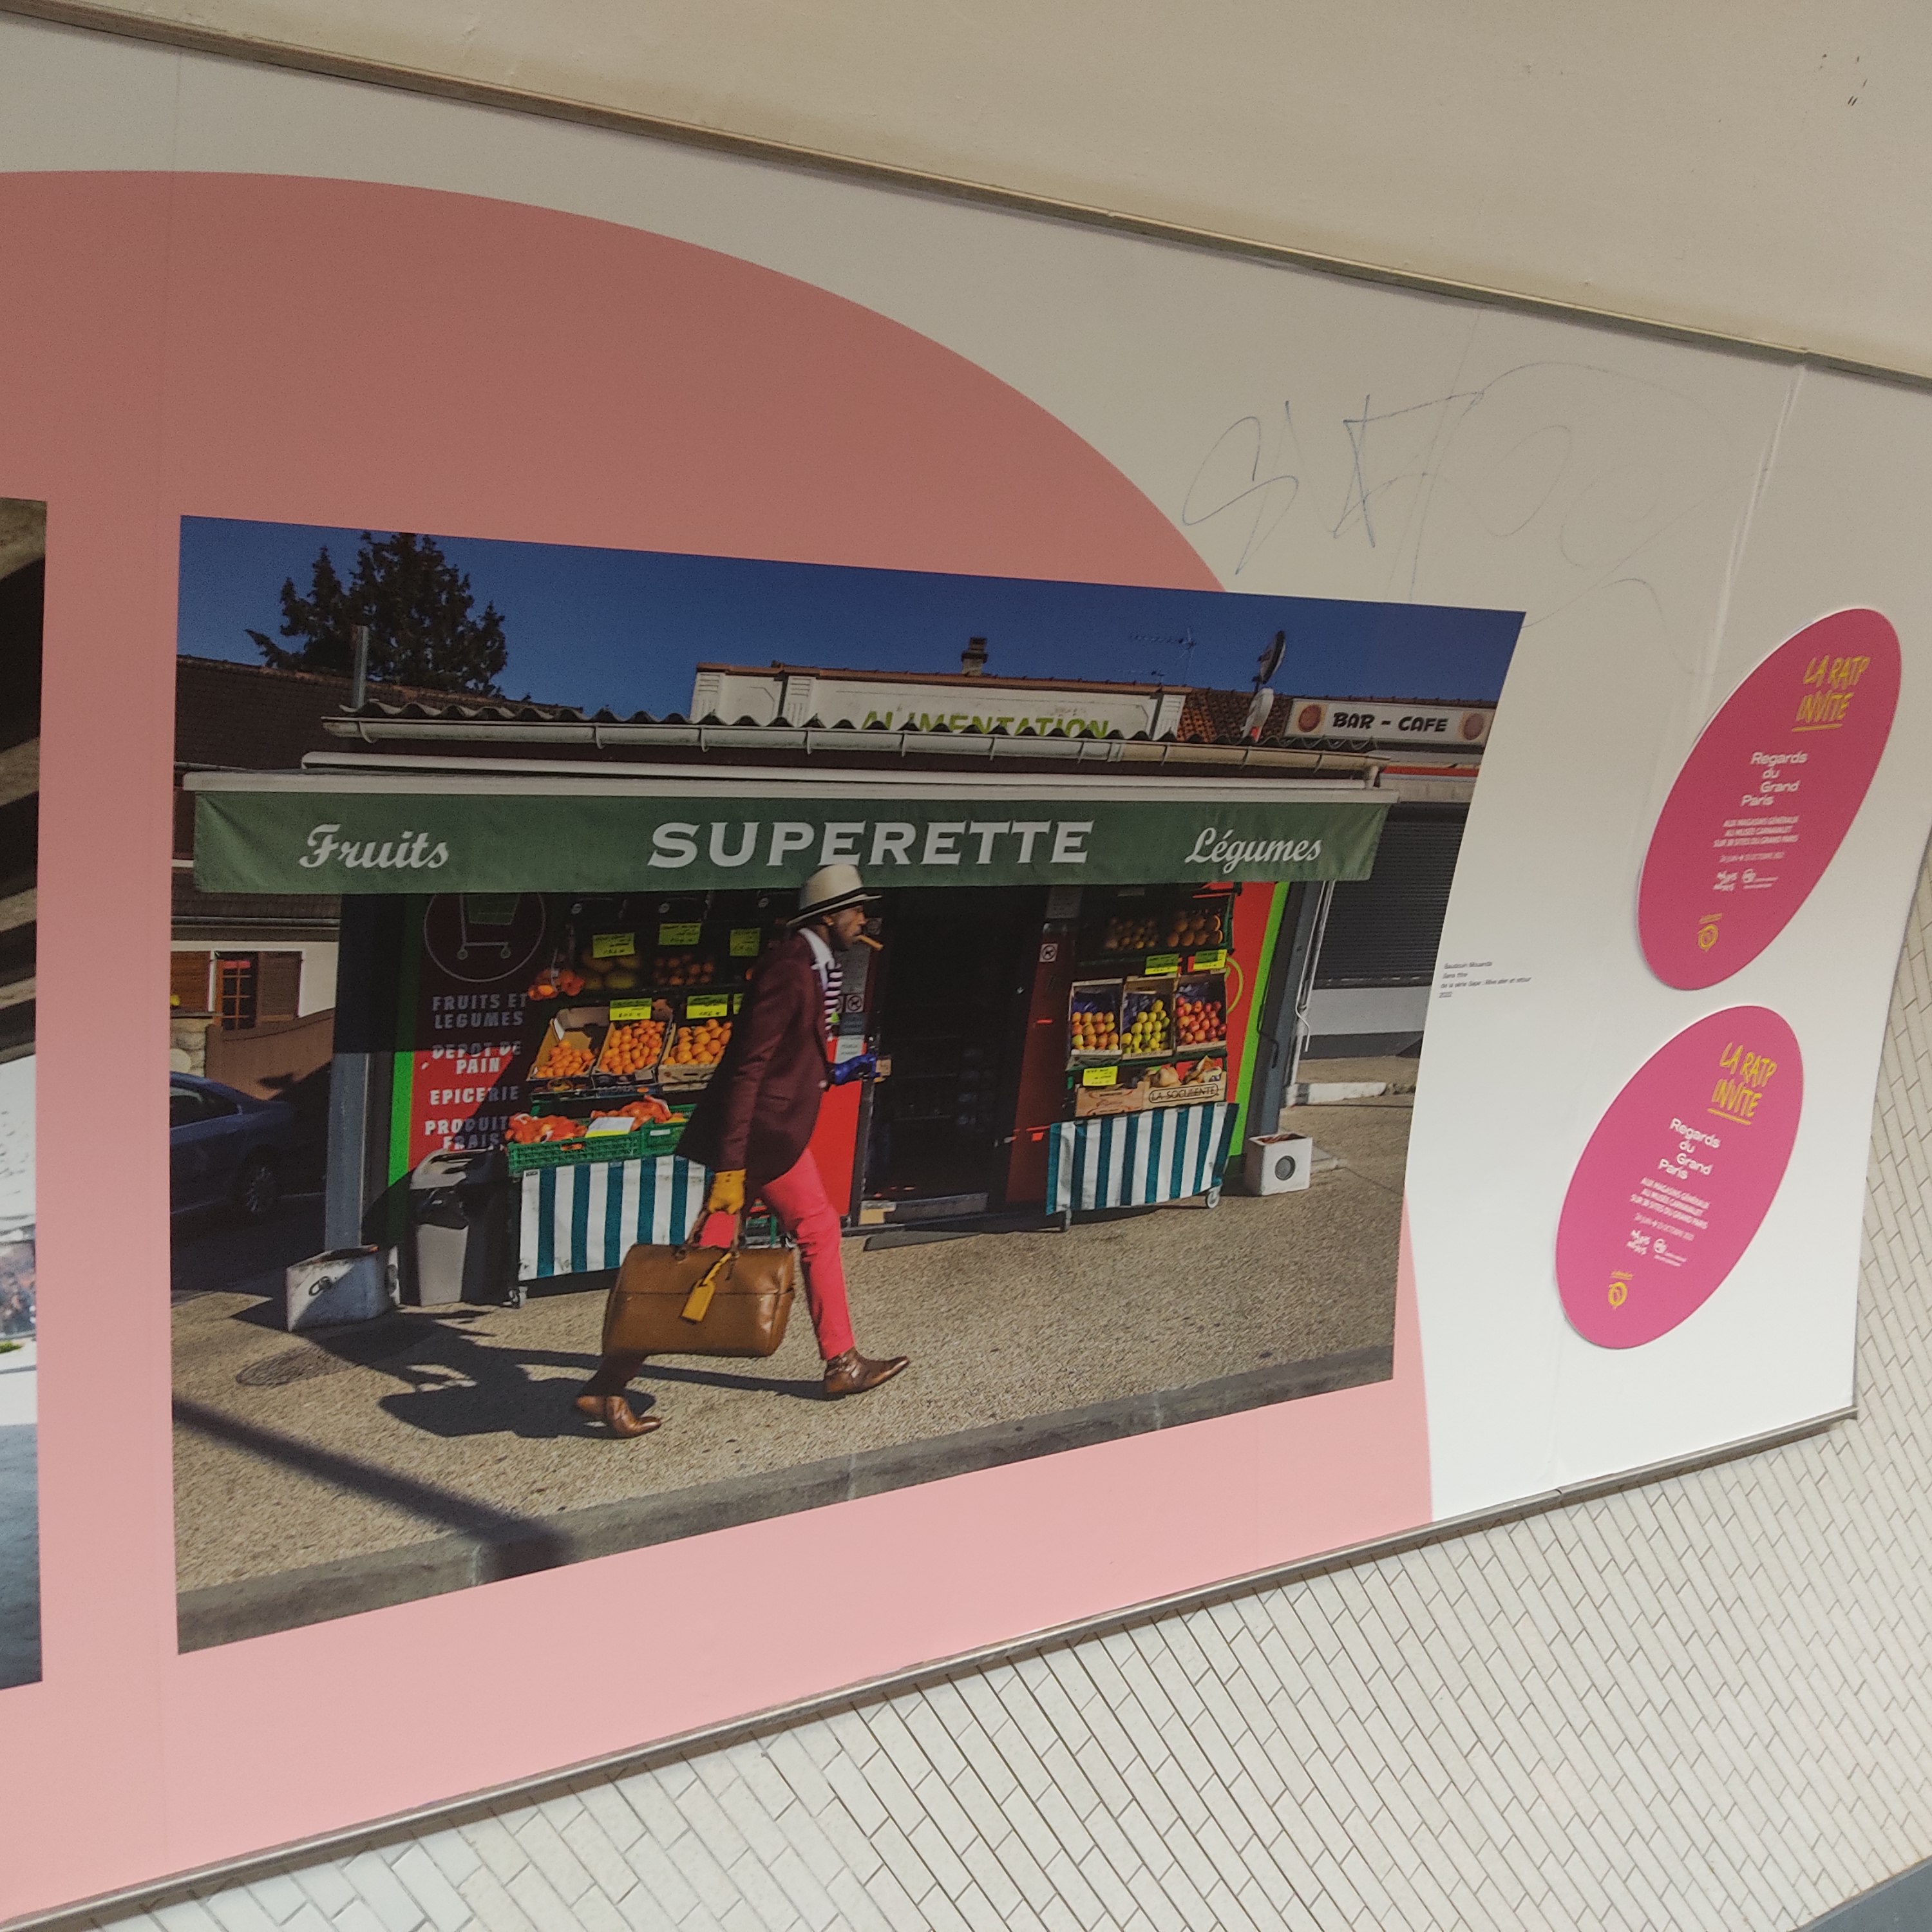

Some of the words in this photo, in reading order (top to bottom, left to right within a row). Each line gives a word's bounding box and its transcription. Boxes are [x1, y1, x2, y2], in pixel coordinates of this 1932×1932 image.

[1803, 656, 1829, 688] LA
[1828, 657, 1870, 690] RATP
[1333, 712, 1375, 729] BAR
[1398, 716, 1448, 732] CAFE
[1751, 751, 1808, 766] Regards
[1762, 768, 1780, 779] du
[1760, 780, 1801, 793] Grand
[1741, 794, 1774, 806] Paris
[299, 824, 449, 868] Fruits
[647, 820, 1094, 869] SUPERETTE
[1184, 827, 1322, 874] Légumes
[432, 994, 500, 1011] FRUITS
[507, 992, 527, 1008] ET
[434, 1011, 524, 1029] LEGUMES
[432, 1042, 492, 1059] DEPOT
[499, 1039, 521, 1056] DE
[456, 1057, 500, 1074] PAIN
[1719, 1043, 1743, 1074] LA
[1740, 1052, 1777, 1087] RATP
[430, 1086, 519, 1106] EPICERIE
[1711, 1079, 1763, 1117] INVITE
[442, 1132, 500, 1150] FRAIS
[1669, 1118, 1721, 1148] Regards
[1680, 1140, 1695, 1153] du
[1658, 1159, 1688, 1180] Paris
[1676, 1153, 1713, 1175] Grand
